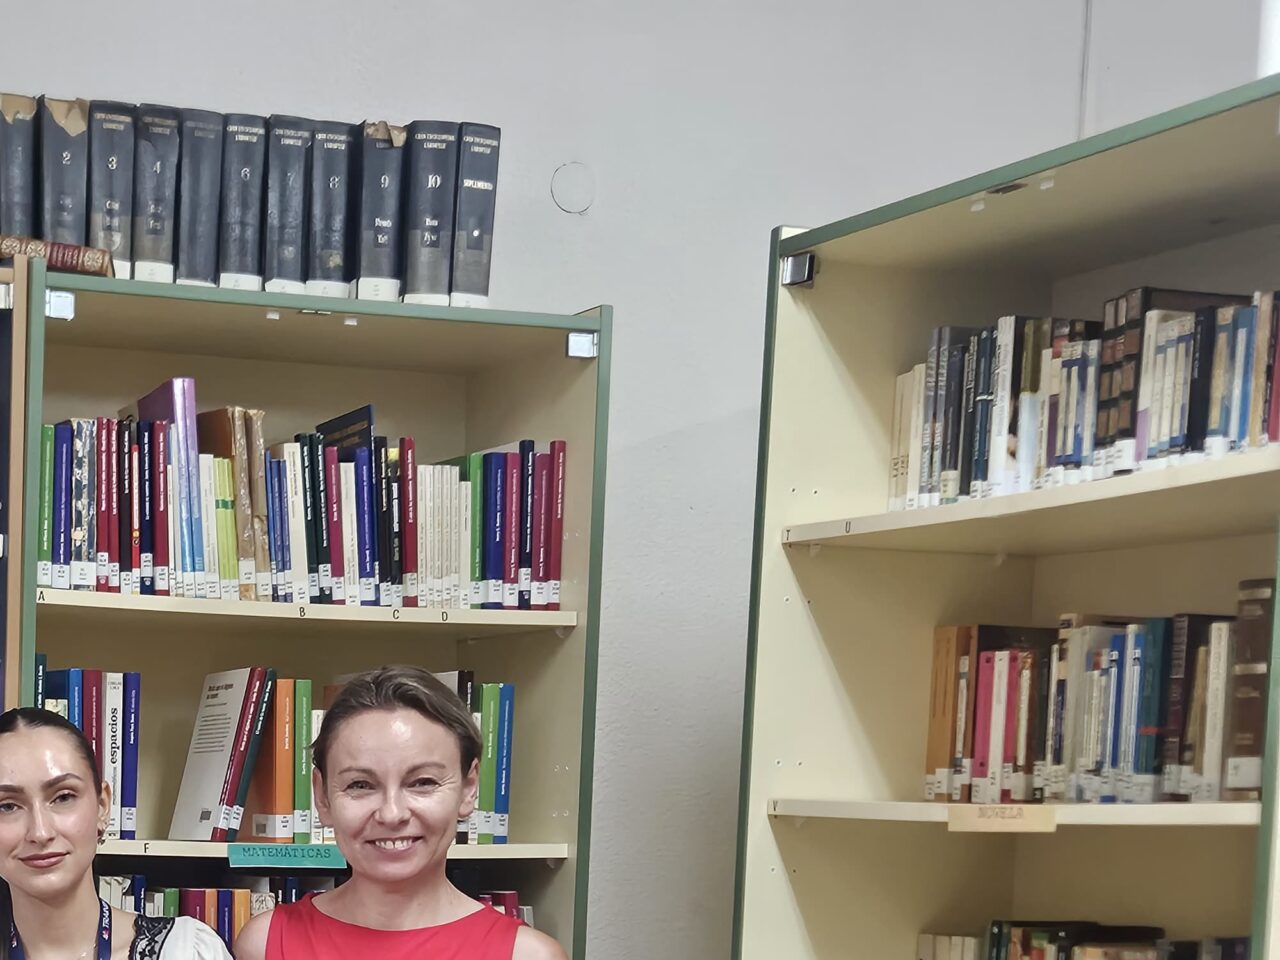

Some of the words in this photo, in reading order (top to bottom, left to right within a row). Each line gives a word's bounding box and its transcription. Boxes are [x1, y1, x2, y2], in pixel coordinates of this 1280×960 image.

[62, 152, 72, 166] 2
[108, 156, 118, 170] 3
[152, 160, 161, 174] 4
[240, 167, 250, 182] 6
[329, 176, 340, 190] 8
[380, 175, 390, 188] 9
[426, 174, 441, 190] 10
[844, 521, 852, 533] U
[785, 528, 791, 542] T
[38, 591, 46, 602] A
[298, 606, 306, 618] B
[392, 608, 400, 620] C
[441, 611, 448, 622] D
[108, 708, 120, 764] espacios
[144, 843, 150, 854] F
[242, 846, 331, 858] MATEMÁTICAS
